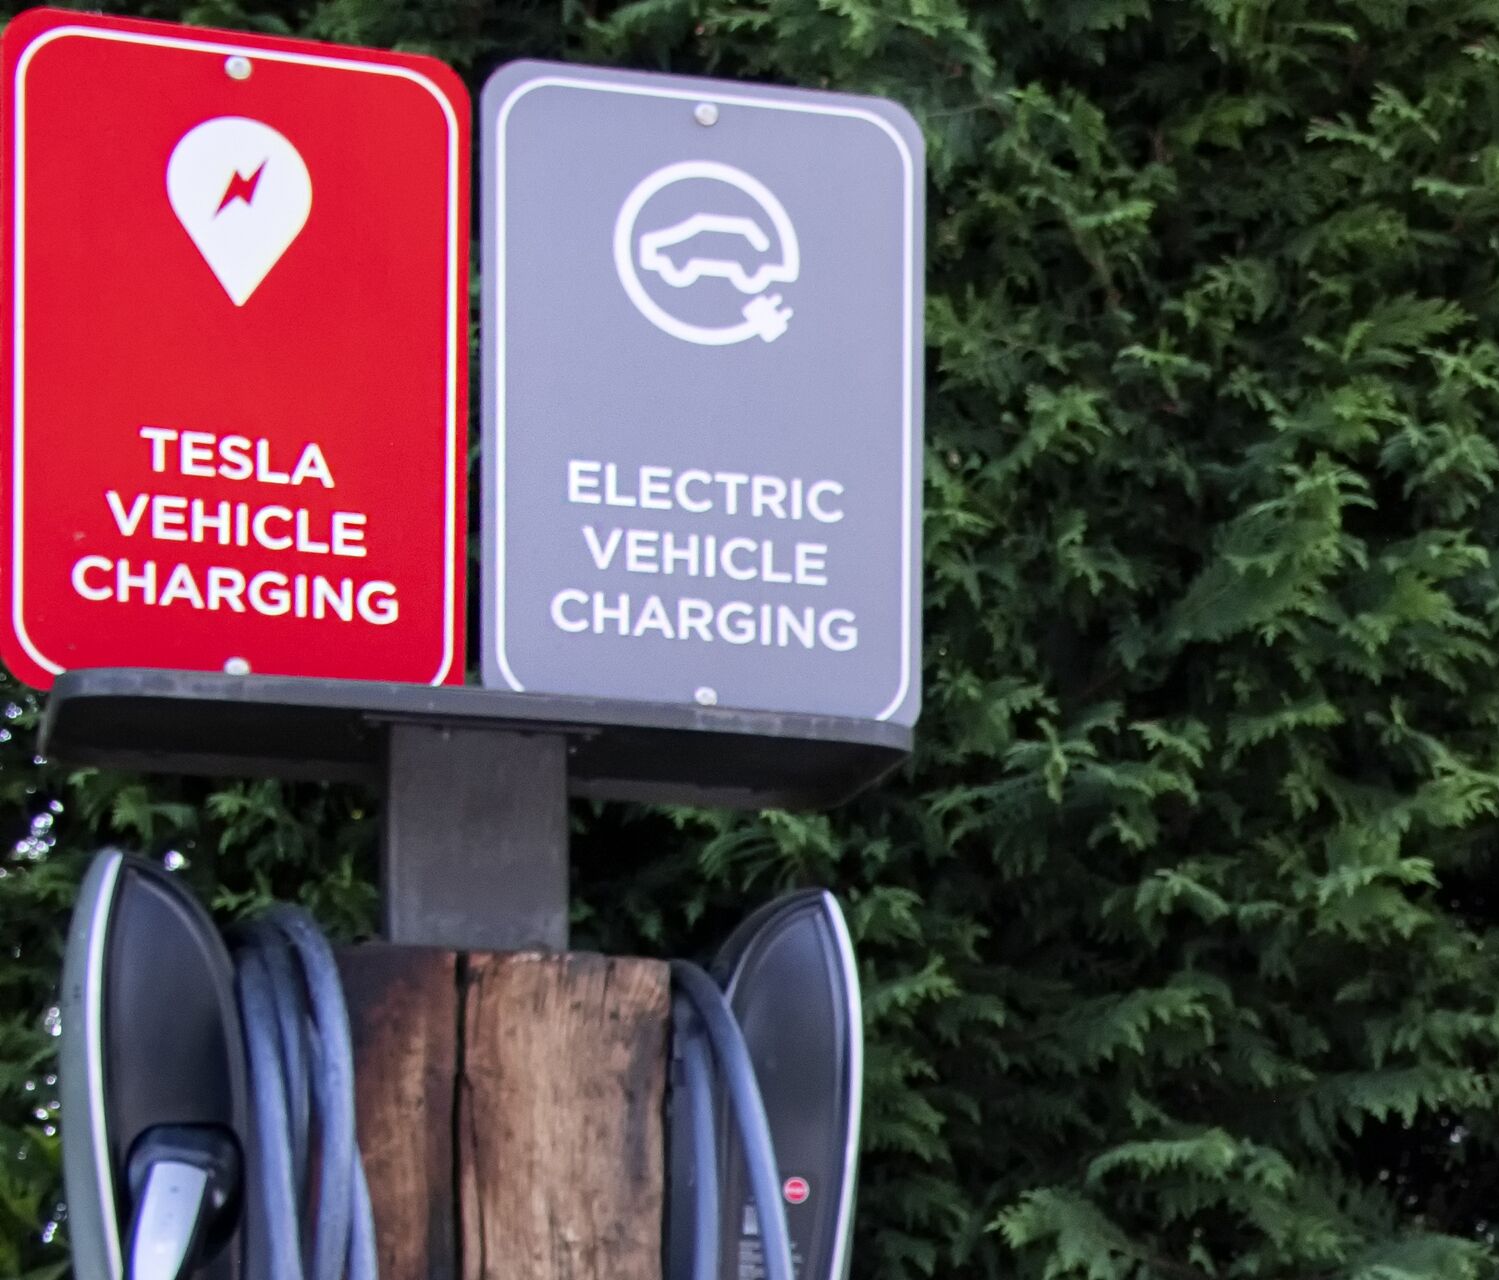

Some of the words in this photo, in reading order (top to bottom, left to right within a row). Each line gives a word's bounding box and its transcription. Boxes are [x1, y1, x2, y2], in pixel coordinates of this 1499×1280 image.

[140, 427, 335, 489] TESLA
[567, 459, 845, 523] ELECTRIC
[106, 490, 367, 558] VEHICLE
[582, 525, 829, 586] VEHICLE
[71, 555, 400, 625] CHARGING
[550, 588, 858, 651] CHARGING
